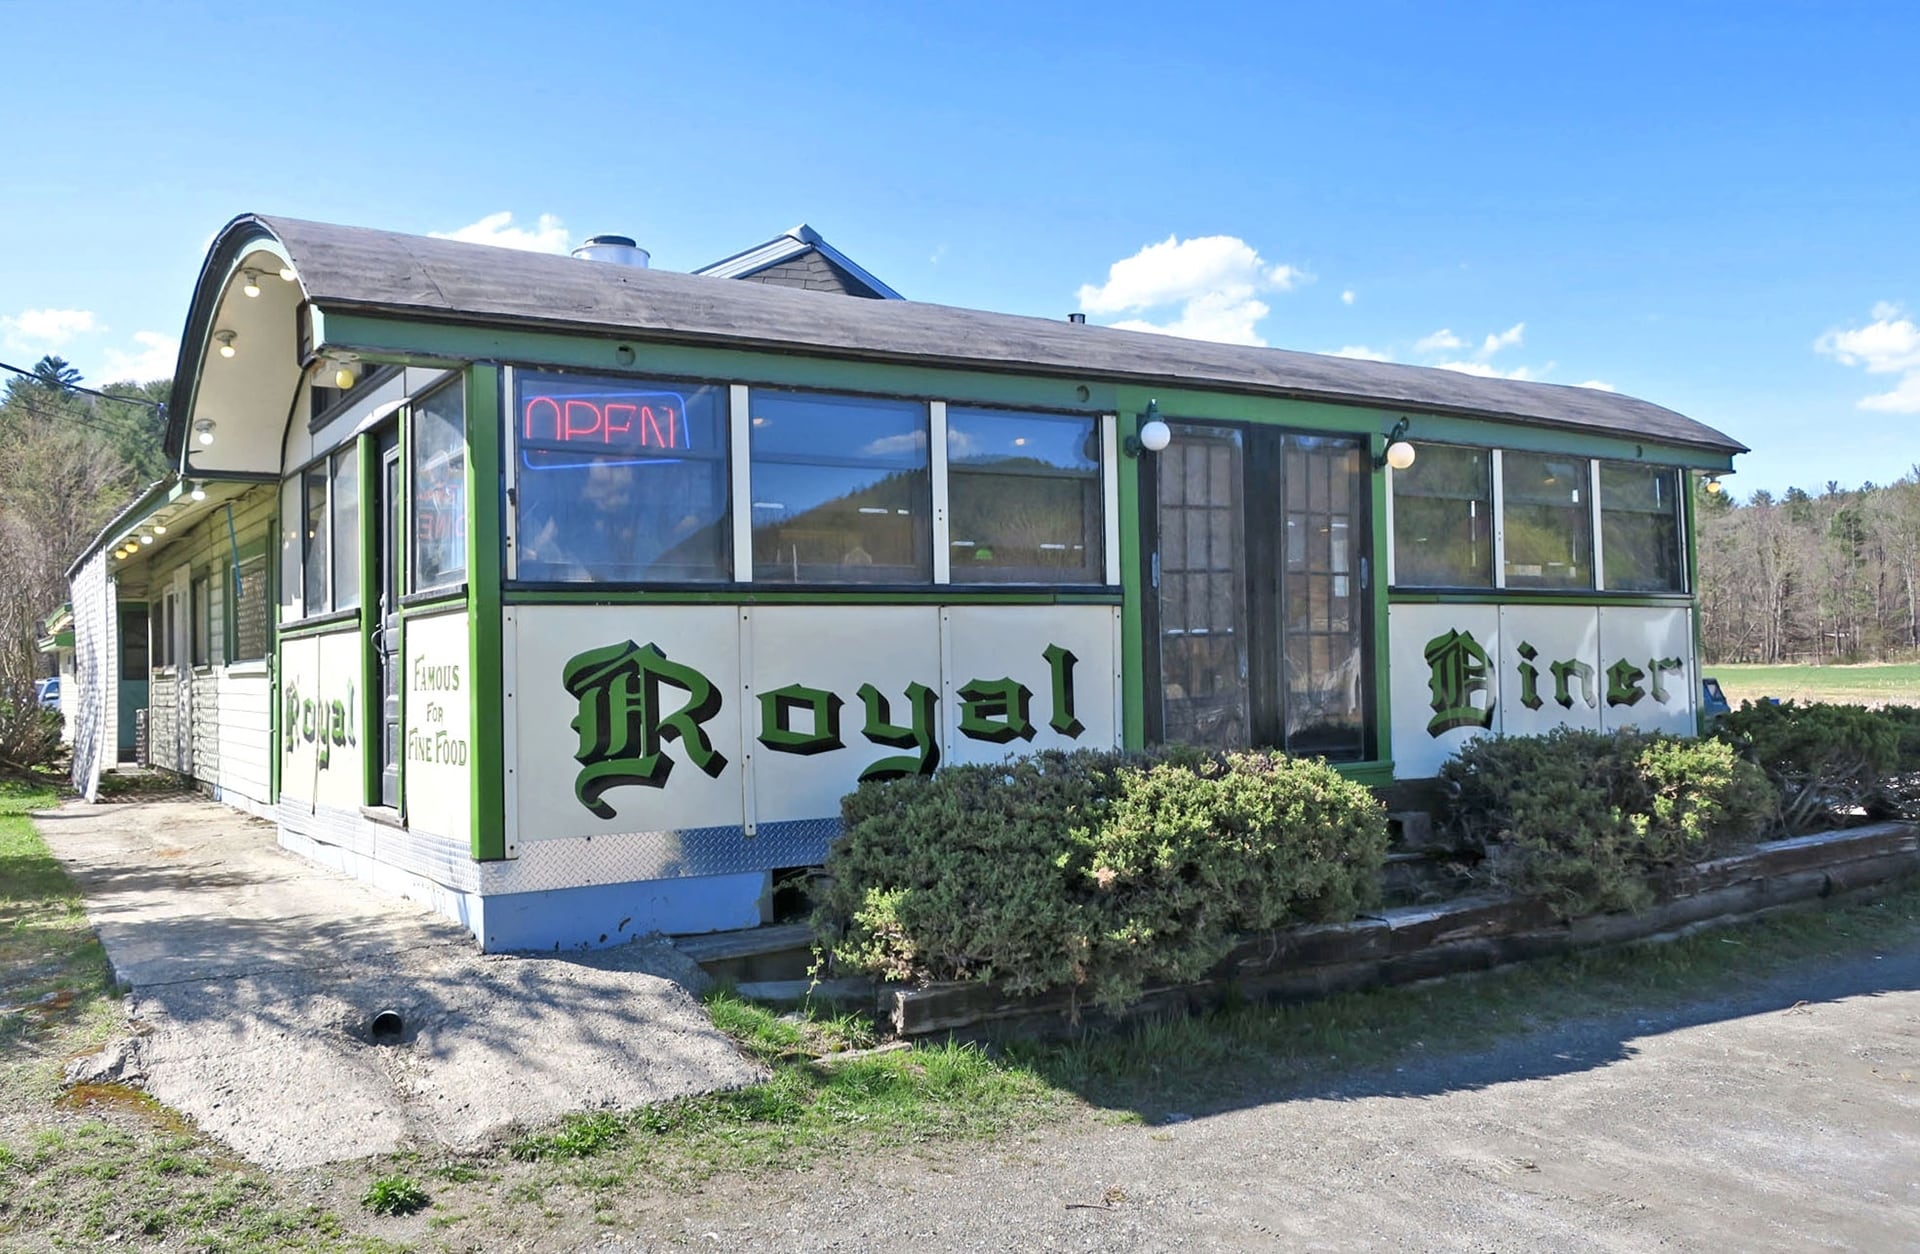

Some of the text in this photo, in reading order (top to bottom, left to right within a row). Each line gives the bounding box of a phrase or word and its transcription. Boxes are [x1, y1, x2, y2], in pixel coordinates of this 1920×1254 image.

[526, 395, 676, 454] OPEN
[413, 653, 460, 692] FAMOUS
[285, 674, 356, 771] Royal
[426, 701, 444, 726] FOR
[562, 627, 1685, 820] Royal Diner
[407, 727, 467, 766] FINE FOOD
